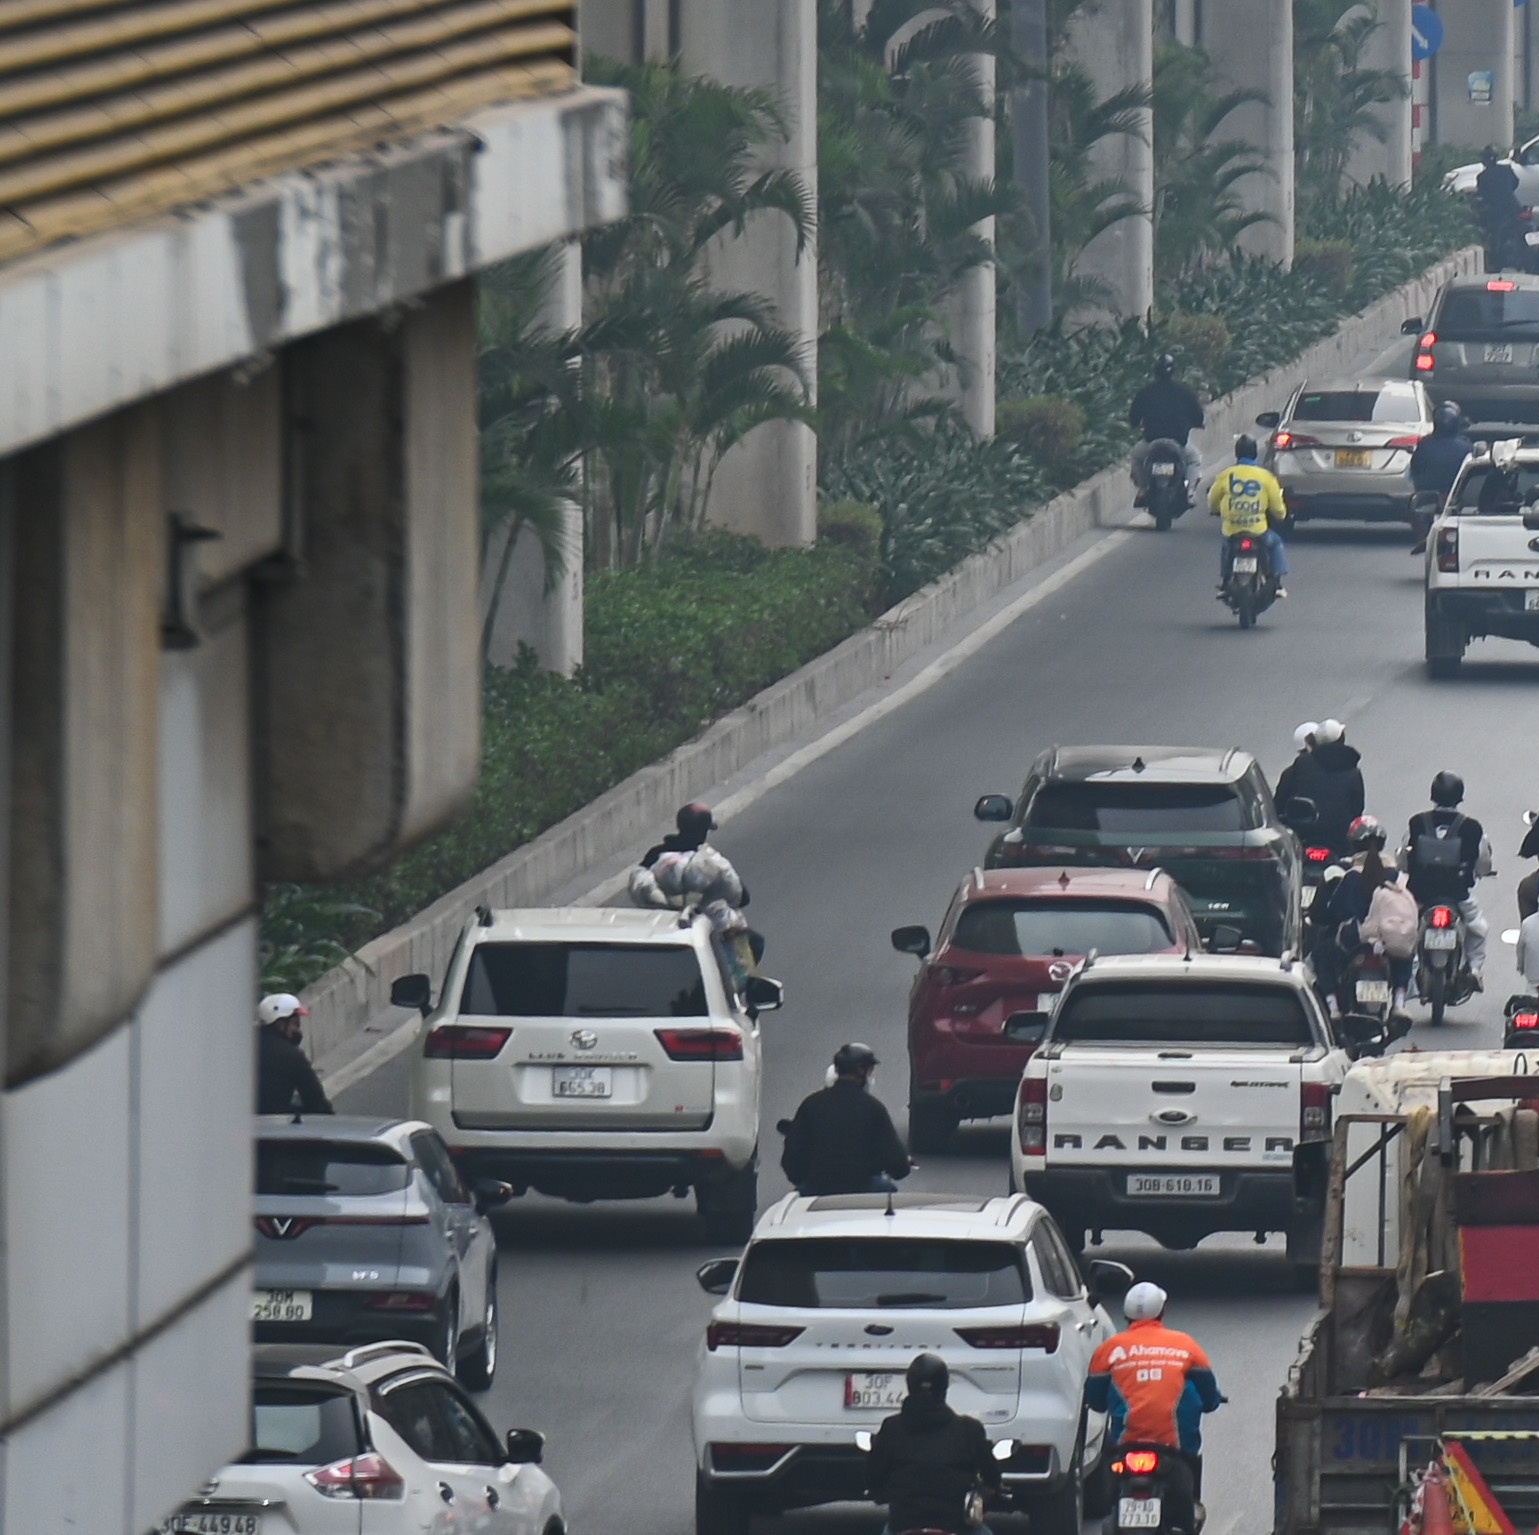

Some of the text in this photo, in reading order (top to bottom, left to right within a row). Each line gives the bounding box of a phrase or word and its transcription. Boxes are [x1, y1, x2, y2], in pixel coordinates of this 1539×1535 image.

[1229, 473, 1261, 497] be
[1054, 1134, 1293, 1153] RANGER
[1129, 1344, 1190, 1358] Ahamove
